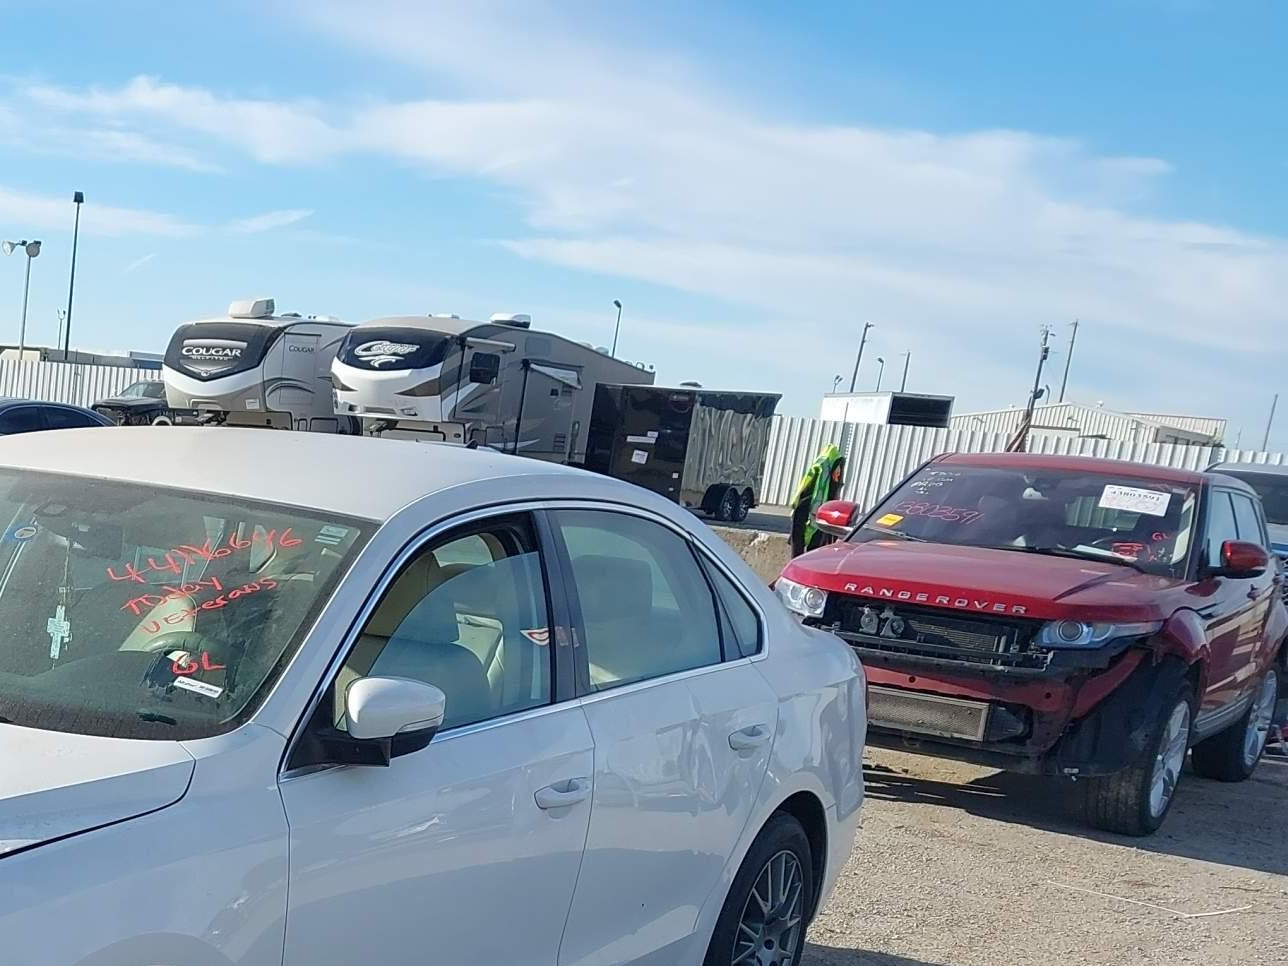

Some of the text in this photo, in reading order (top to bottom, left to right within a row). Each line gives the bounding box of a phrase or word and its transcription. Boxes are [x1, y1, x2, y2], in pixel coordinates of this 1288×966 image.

[182, 346, 241, 356] COUGAR
[844, 582, 1028, 615] RANGE ROVER
